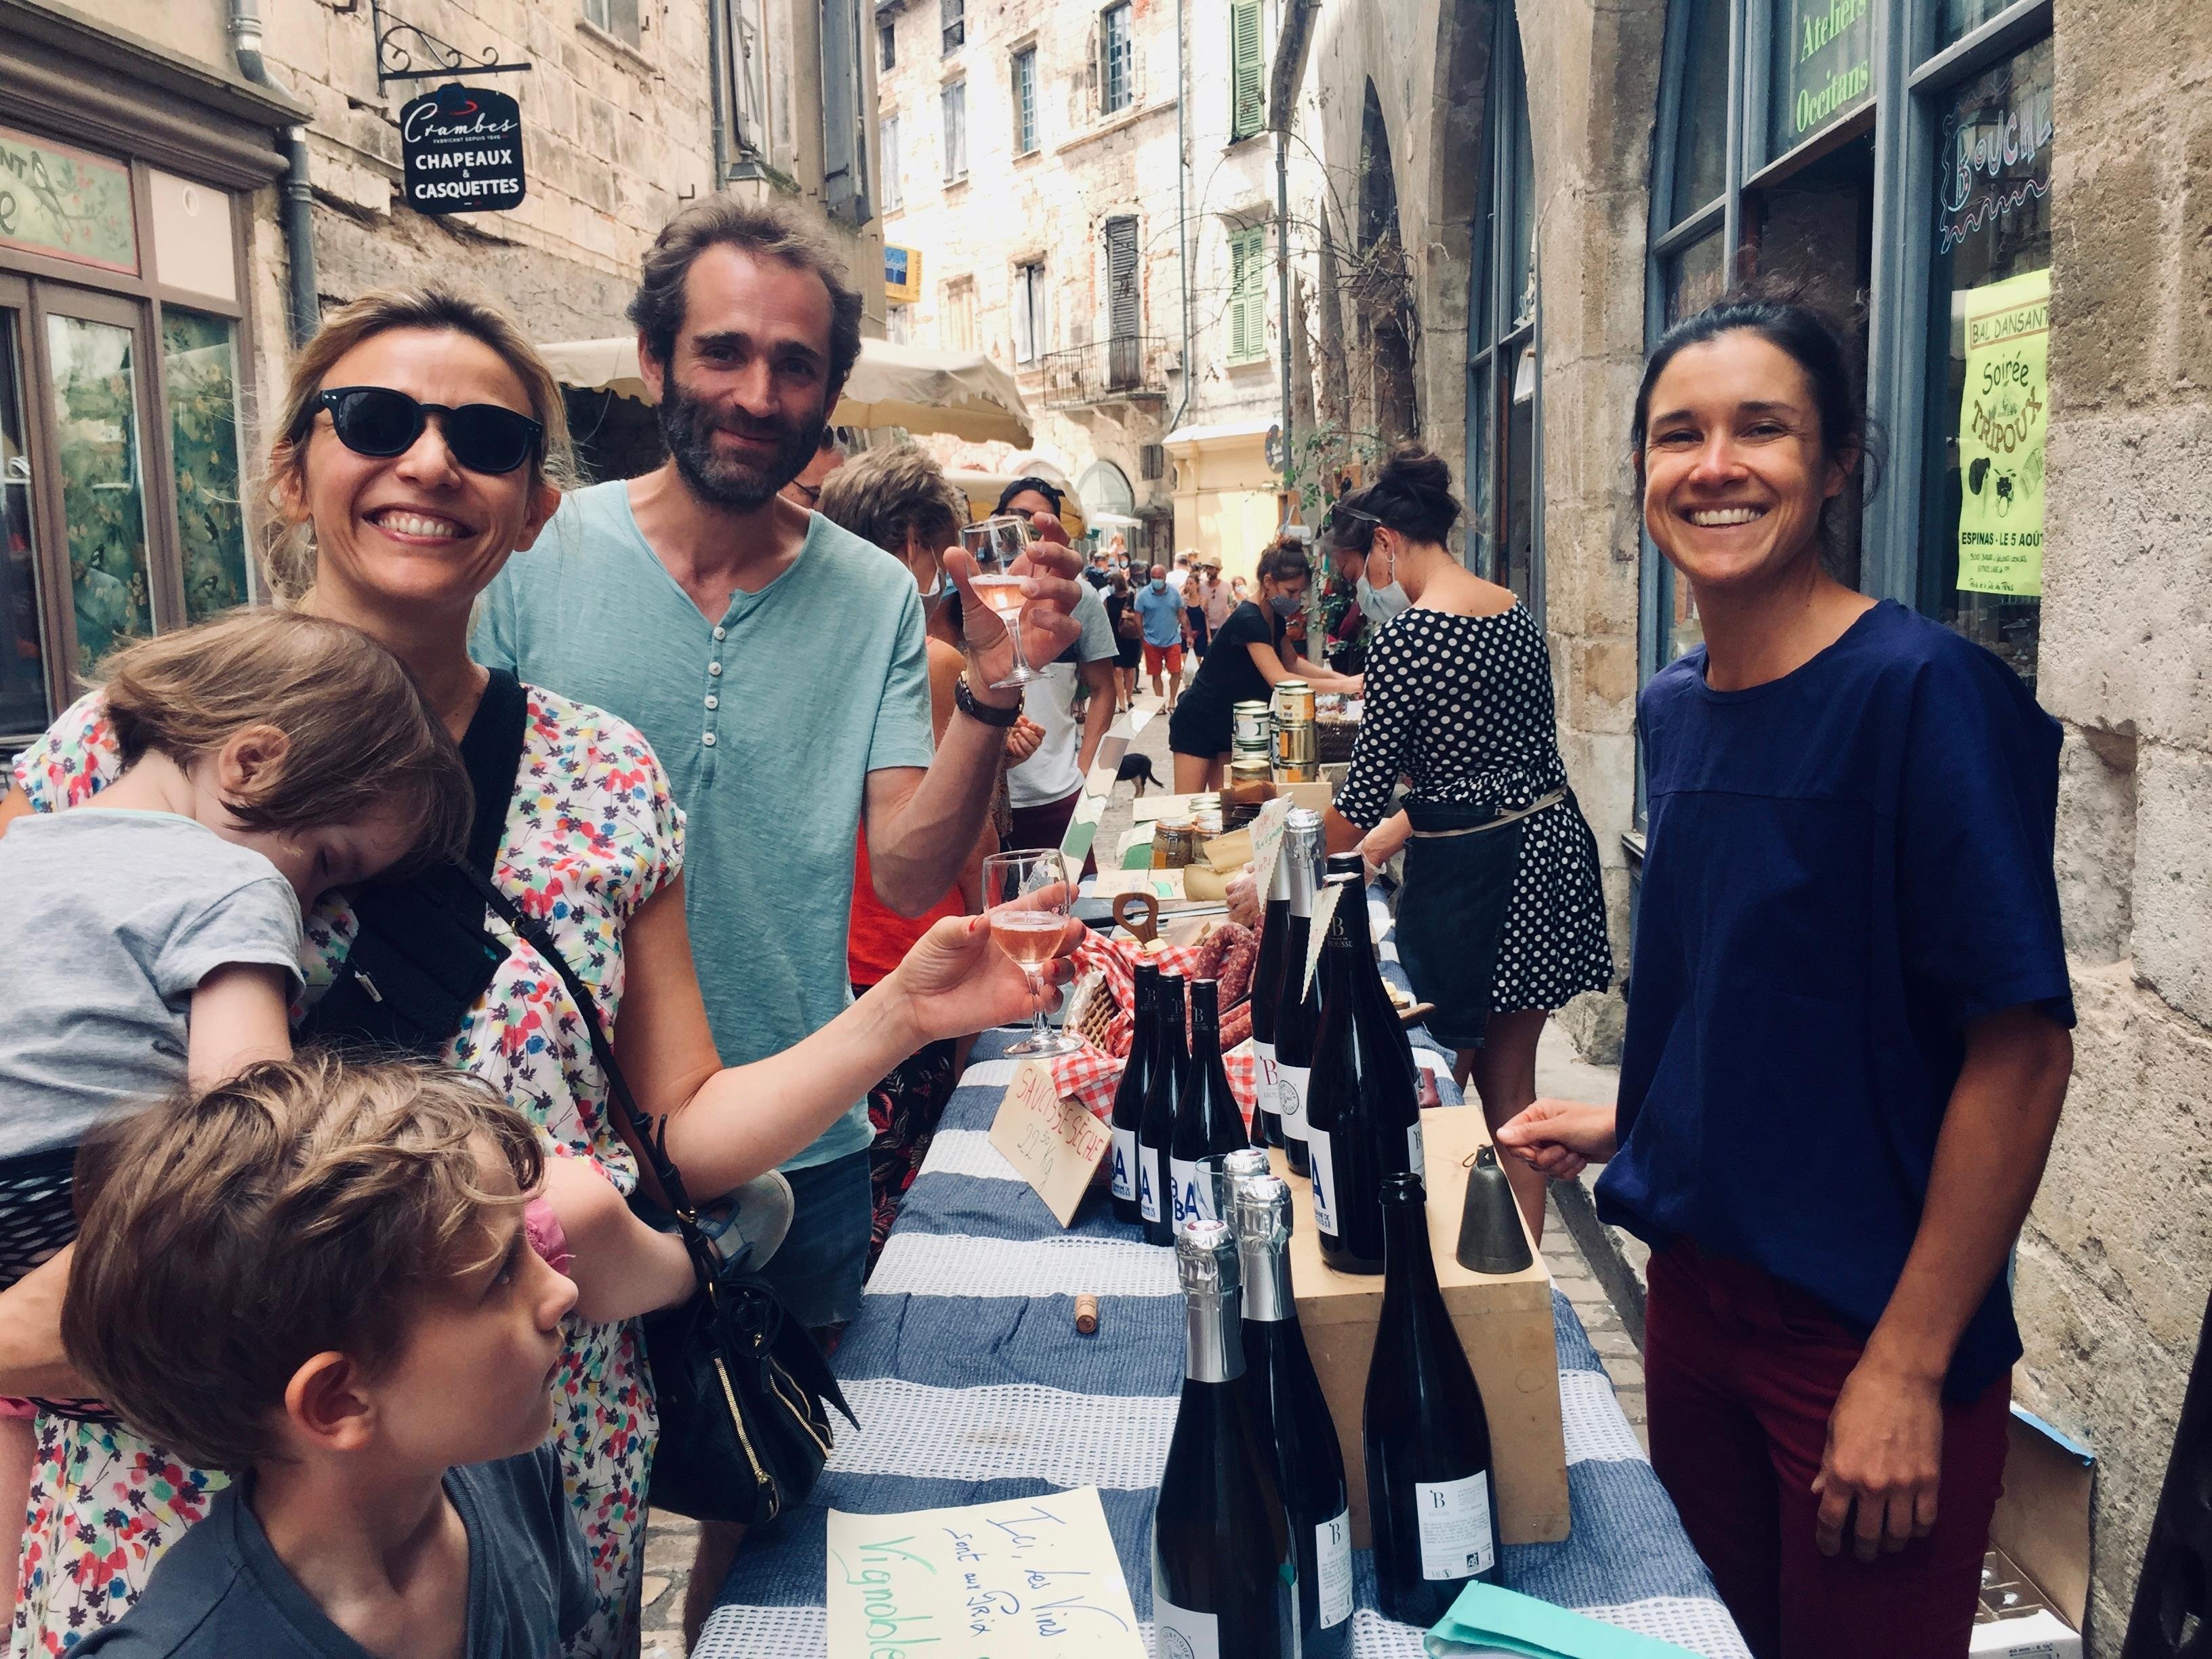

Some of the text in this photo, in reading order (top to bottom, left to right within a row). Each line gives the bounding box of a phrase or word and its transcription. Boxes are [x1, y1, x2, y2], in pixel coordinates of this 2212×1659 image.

[1801, 0, 1867, 64] Ateliers
[1797, 60, 1869, 133] Occitans
[405, 103, 518, 143] Crambes
[415, 150, 513, 169] CHAPEAUX
[462, 169, 470, 178] &
[415, 178, 520, 199] CASQUETTES
[1973, 322, 1990, 344] BAL
[1982, 350, 2028, 395] Soirée
[1971, 386, 2043, 453] TRIPOUX
[1962, 532, 1994, 545] ESPINAS
[2000, 533, 2009, 546] LE
[2011, 533, 2017, 546] 5
[1017, 1068, 1073, 1134] SAUCISSE
[964, 1572, 981, 1590] aux
[1030, 1595, 1129, 1637] Vins
